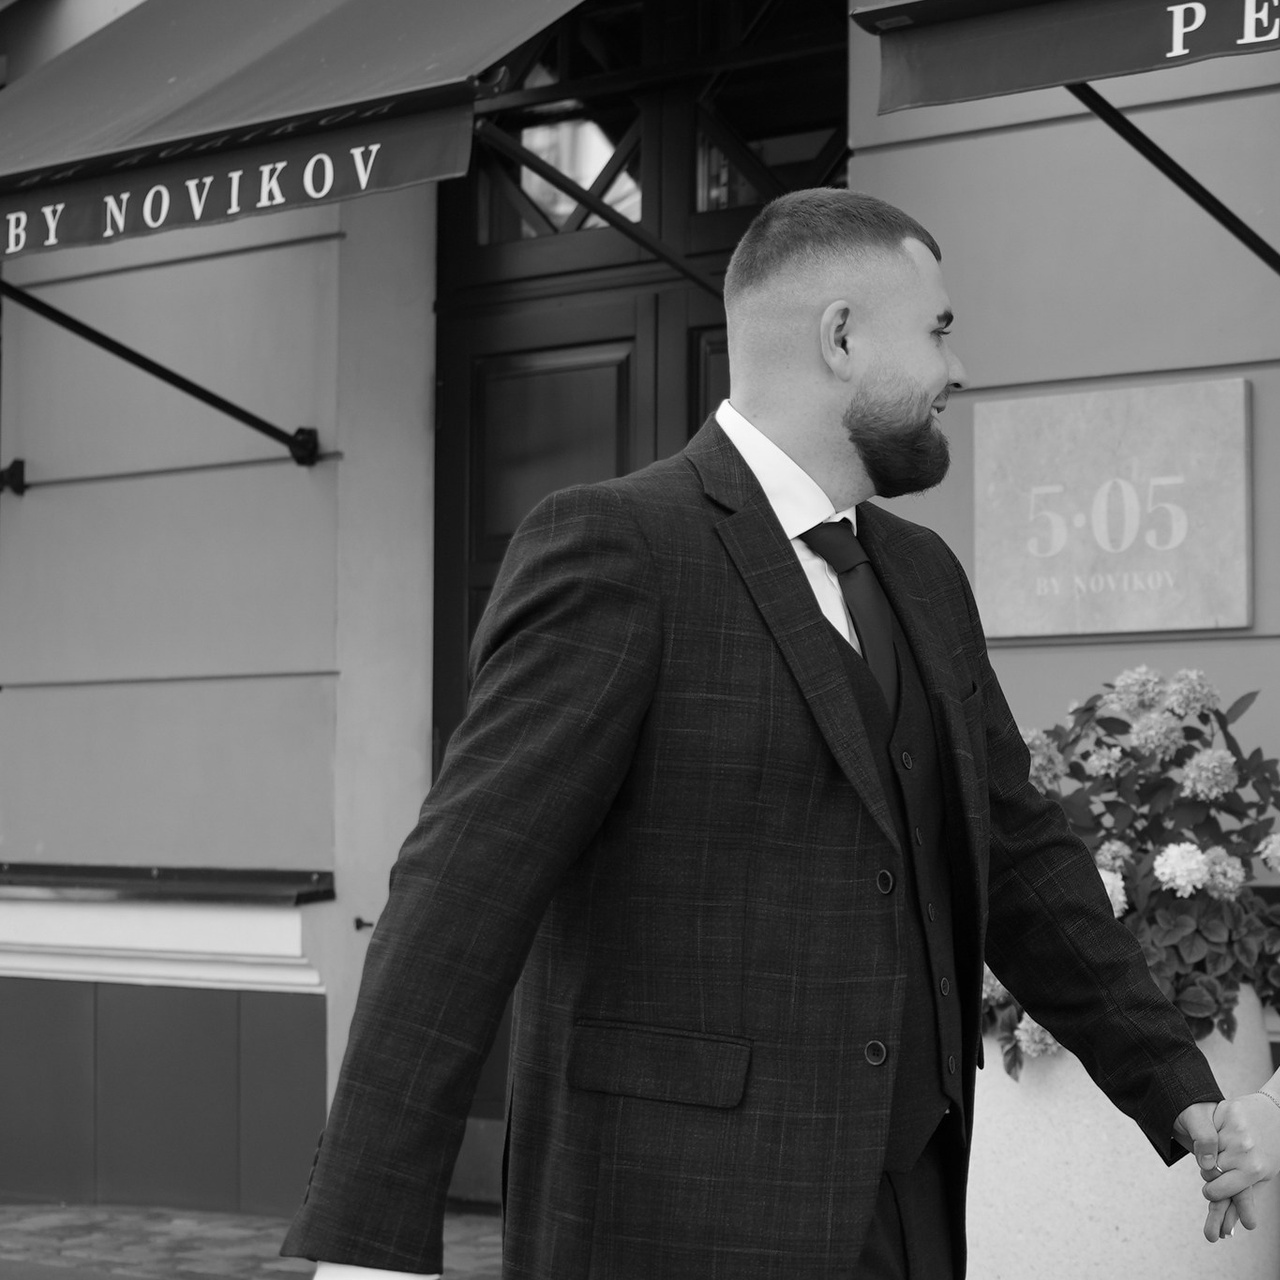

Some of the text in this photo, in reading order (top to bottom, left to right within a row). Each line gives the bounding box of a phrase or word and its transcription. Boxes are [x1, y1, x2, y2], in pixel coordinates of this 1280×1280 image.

[5, 143, 381, 254] BY NOVIKOV
[1036, 570, 1177, 597] BY NOVIKOV
